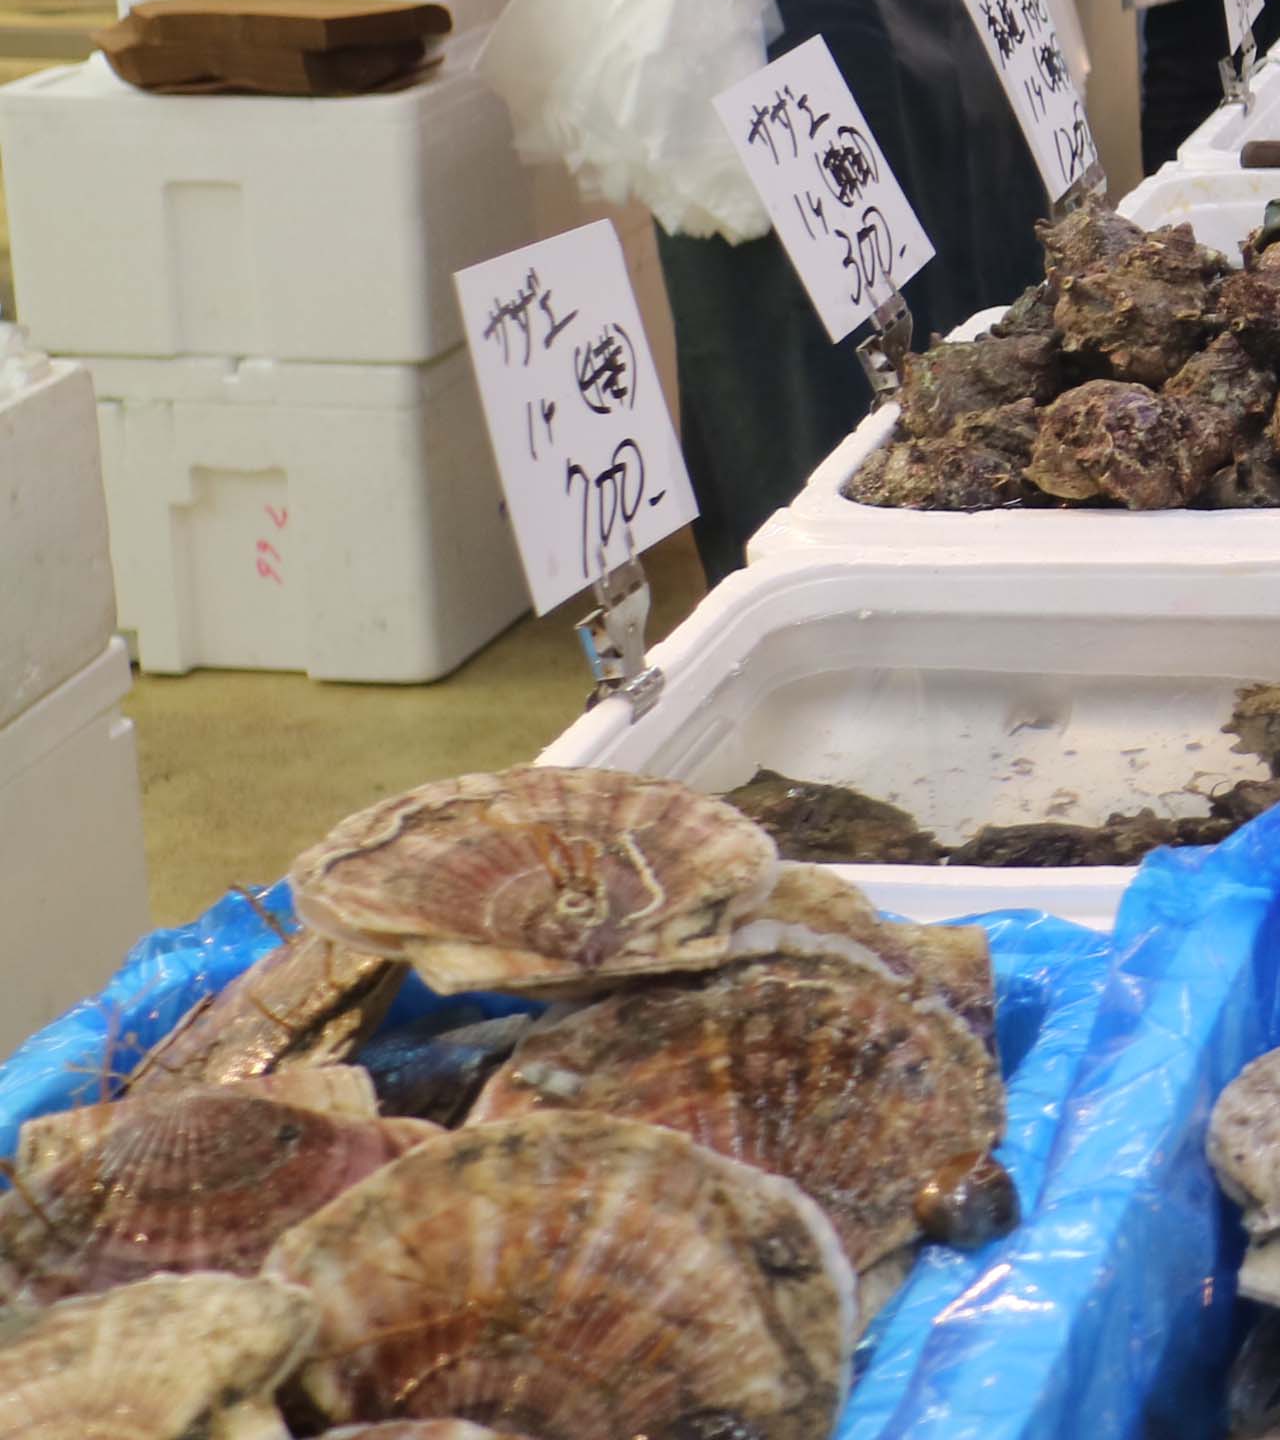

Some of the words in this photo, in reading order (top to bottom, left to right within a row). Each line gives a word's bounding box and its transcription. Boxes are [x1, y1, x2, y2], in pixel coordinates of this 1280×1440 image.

[748, 84, 830, 165] サザエ
[483, 266, 579, 367] サザエ
